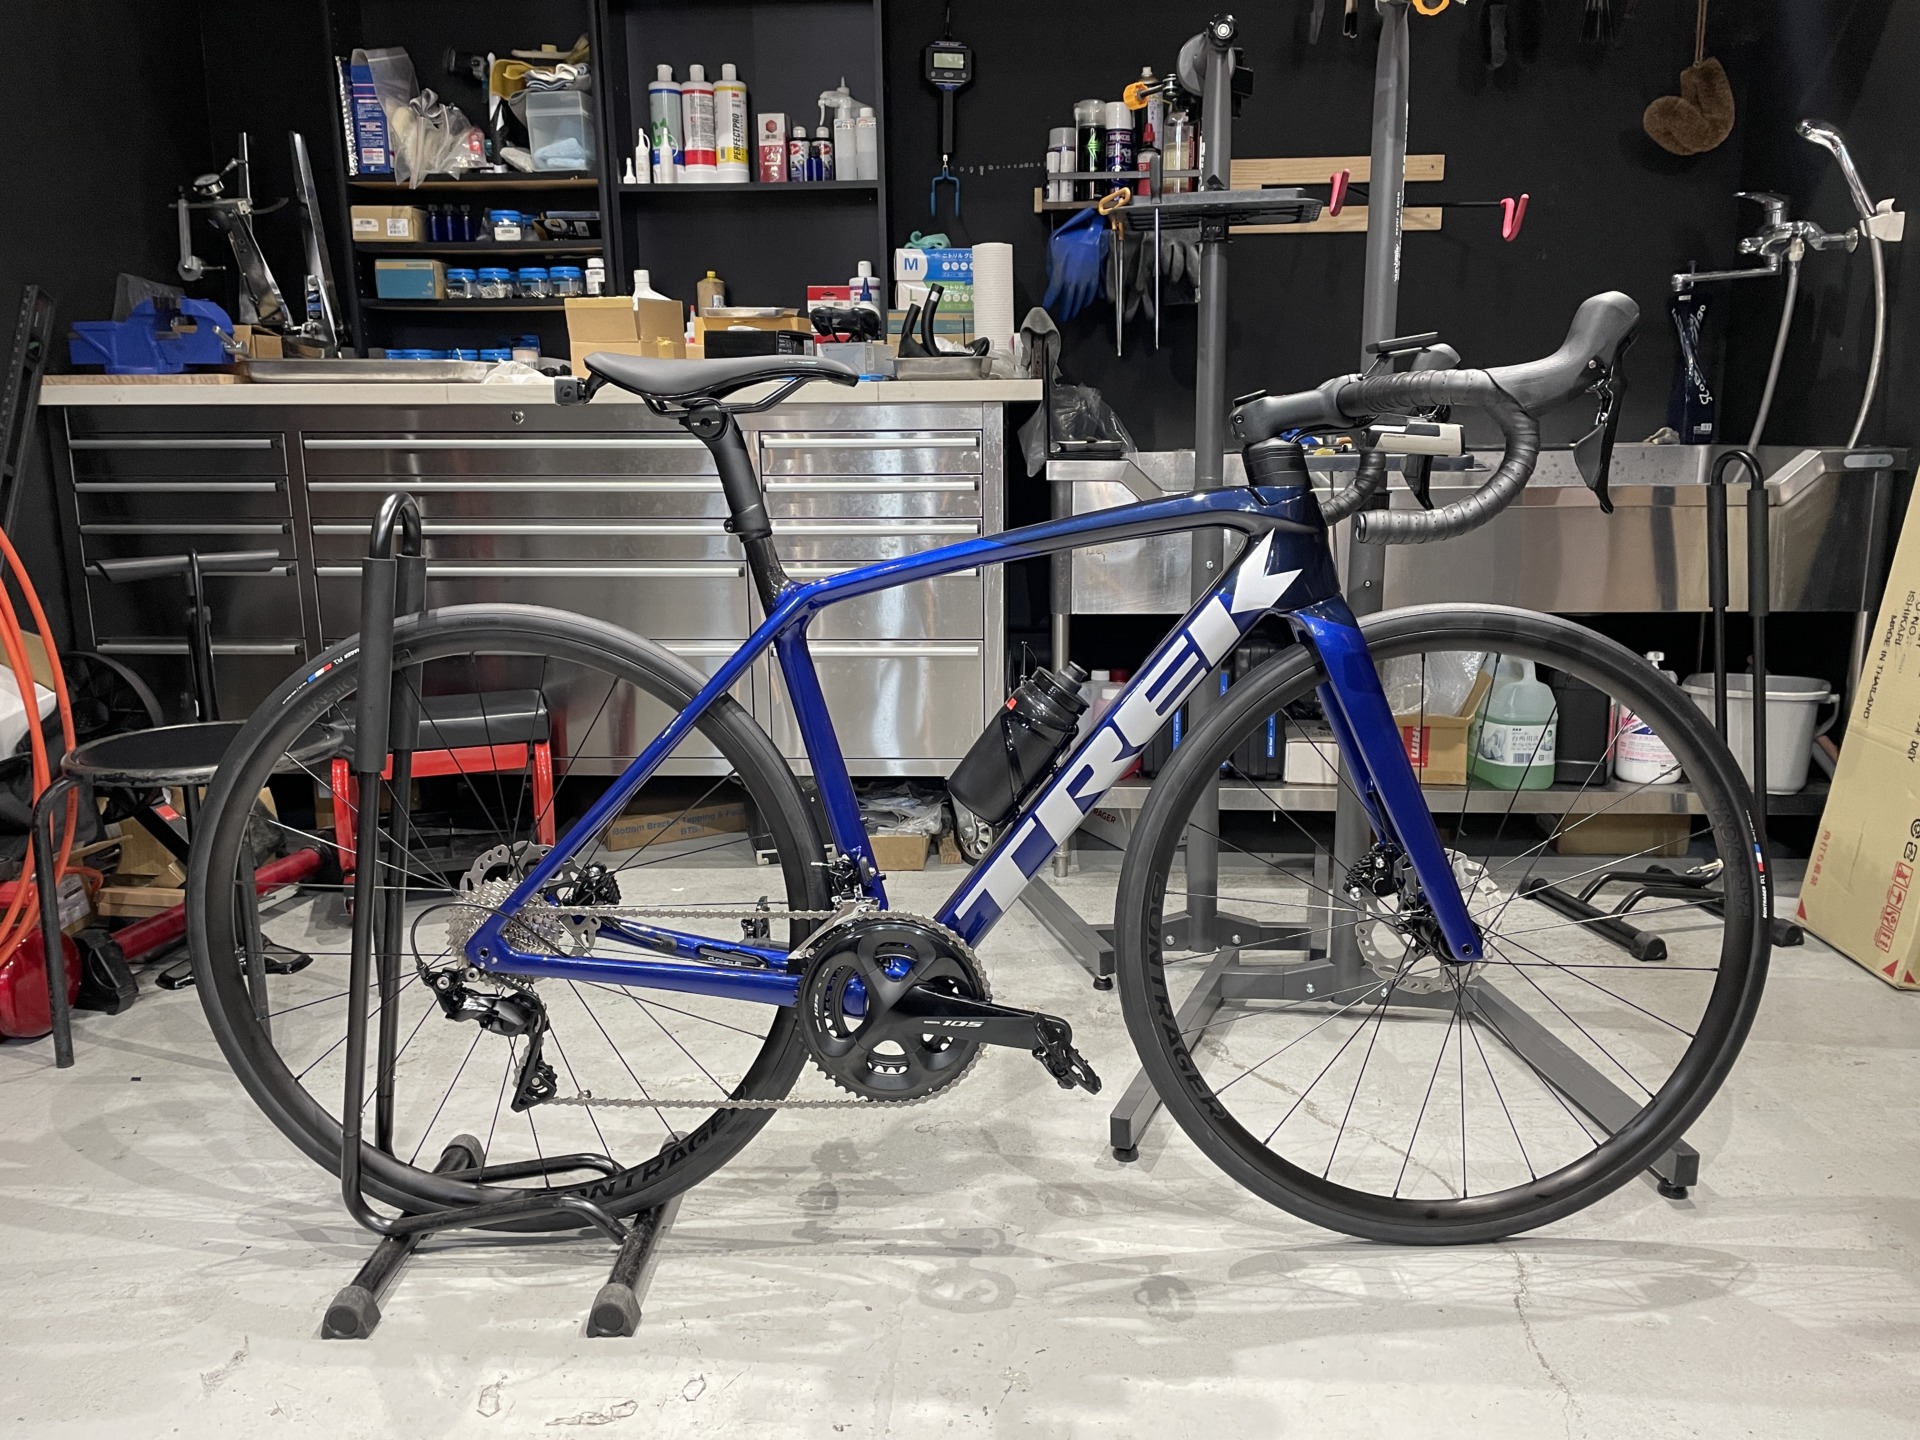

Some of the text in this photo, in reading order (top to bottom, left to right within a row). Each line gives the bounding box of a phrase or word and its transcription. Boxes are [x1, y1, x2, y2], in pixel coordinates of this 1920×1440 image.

[732, 113, 740, 161] PERFECTPRO
[904, 257, 918, 271] M
[909, 289, 918, 302] L
[1878, 650, 1888, 661] IN
[954, 527, 1303, 919] TREK
[612, 825, 645, 836] Bottom
[682, 812, 716, 825] Tapping
[680, 826, 705, 836] BTS-1
[1149, 872, 1227, 1121] BONTRAGER
[942, 1020, 985, 1028] 105
[563, 1084, 748, 1200] ONTRAGER
